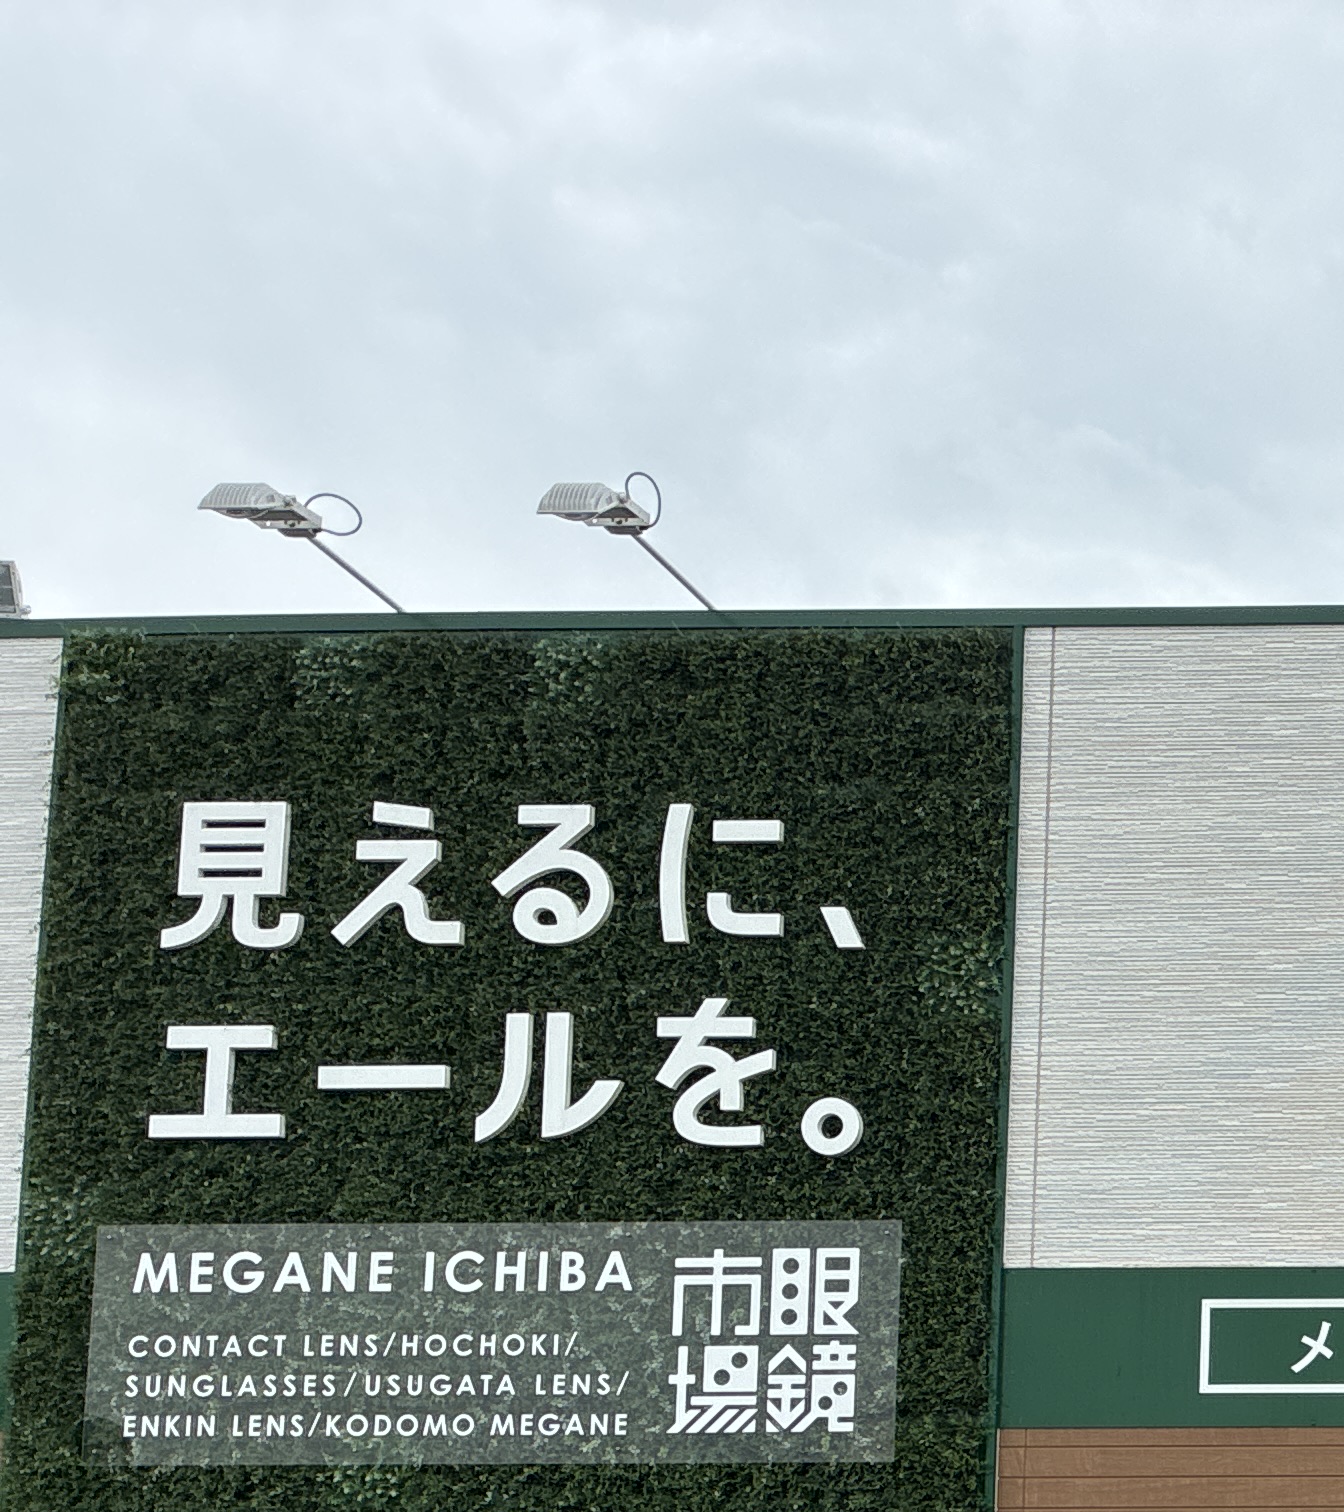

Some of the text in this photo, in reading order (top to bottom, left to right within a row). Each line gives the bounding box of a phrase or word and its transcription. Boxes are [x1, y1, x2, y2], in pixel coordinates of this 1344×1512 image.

[159, 801, 866, 949] 見えるに、
[147, 997, 865, 1157] エールを。
[131, 1249, 634, 1294] MEGANE ICHIBA
[127, 1331, 579, 1358] CONTACT LENS/HOCHOKI/
[124, 1370, 631, 1399] SUNGLASSES/USUGATA LENS/
[121, 1411, 629, 1439] ENKIN LENS/KODOMO MEGANE
